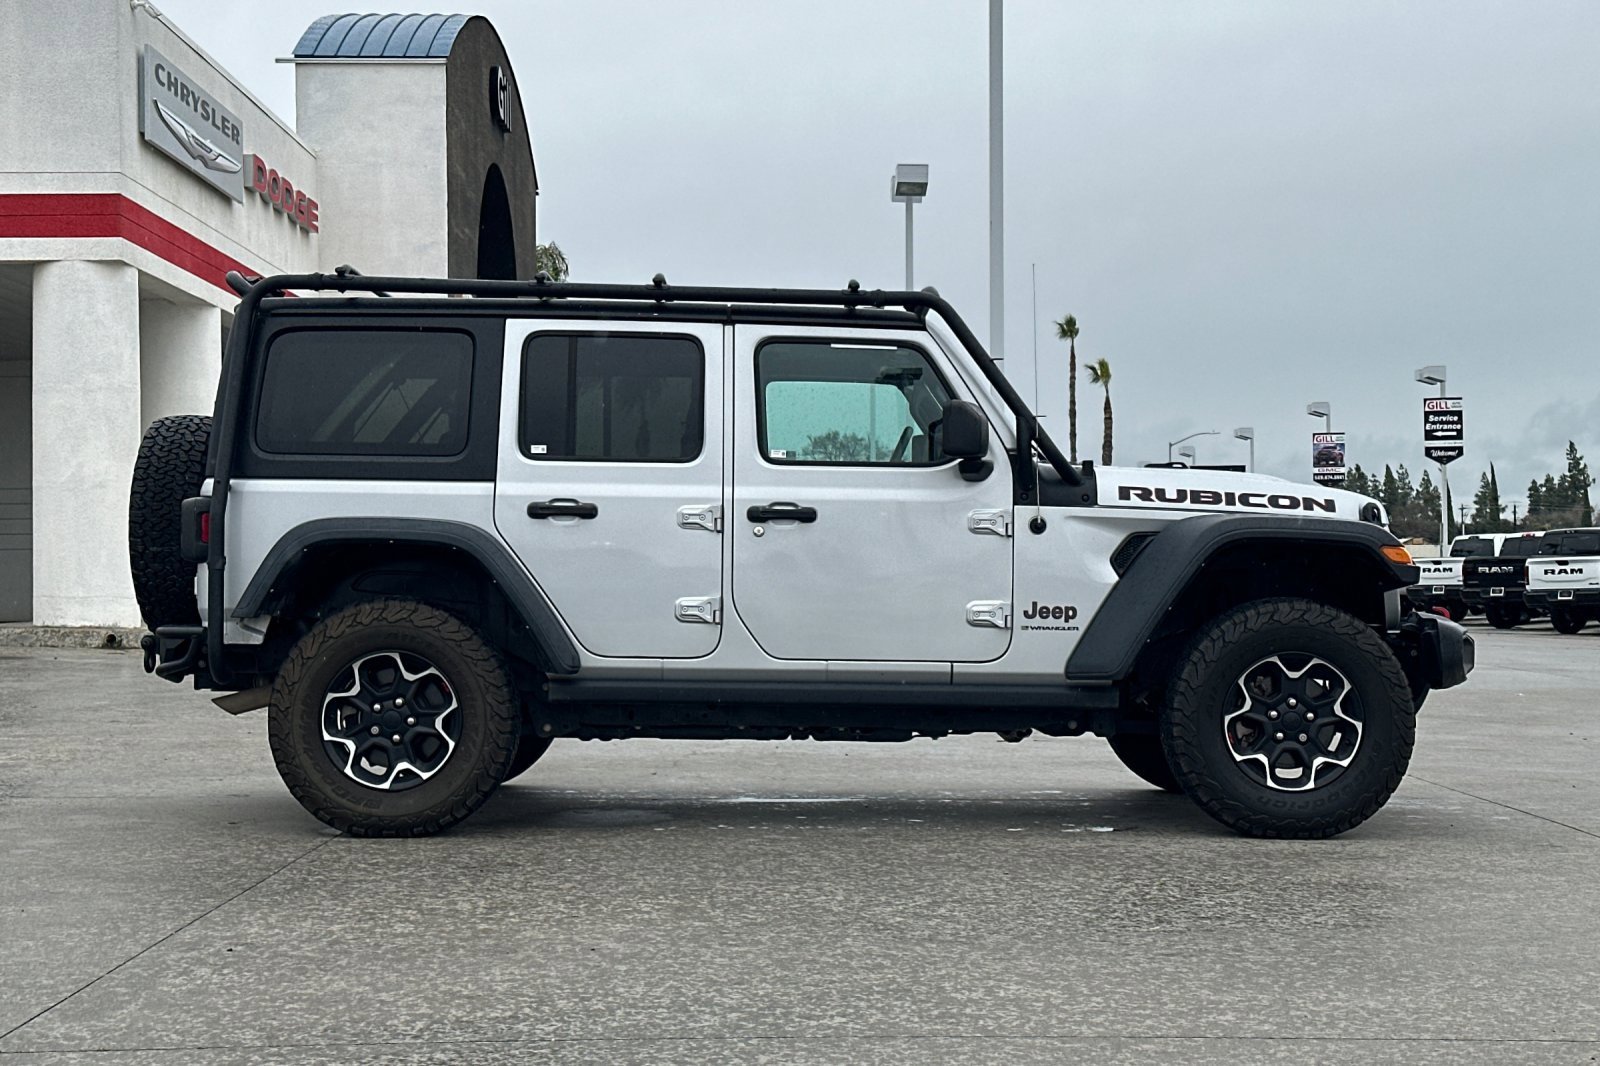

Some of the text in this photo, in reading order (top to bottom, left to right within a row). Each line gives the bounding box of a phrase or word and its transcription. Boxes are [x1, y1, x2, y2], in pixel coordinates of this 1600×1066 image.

[154, 63, 240, 145] CHRYSLER
[250, 153, 319, 233] DODGE
[1427, 400, 1450, 410] GILL
[1425, 423, 1461, 431] Entrance
[1118, 485, 1337, 513] RUBICON
[1478, 566, 1514, 574] RAM
[1023, 601, 1078, 623] Jeep
